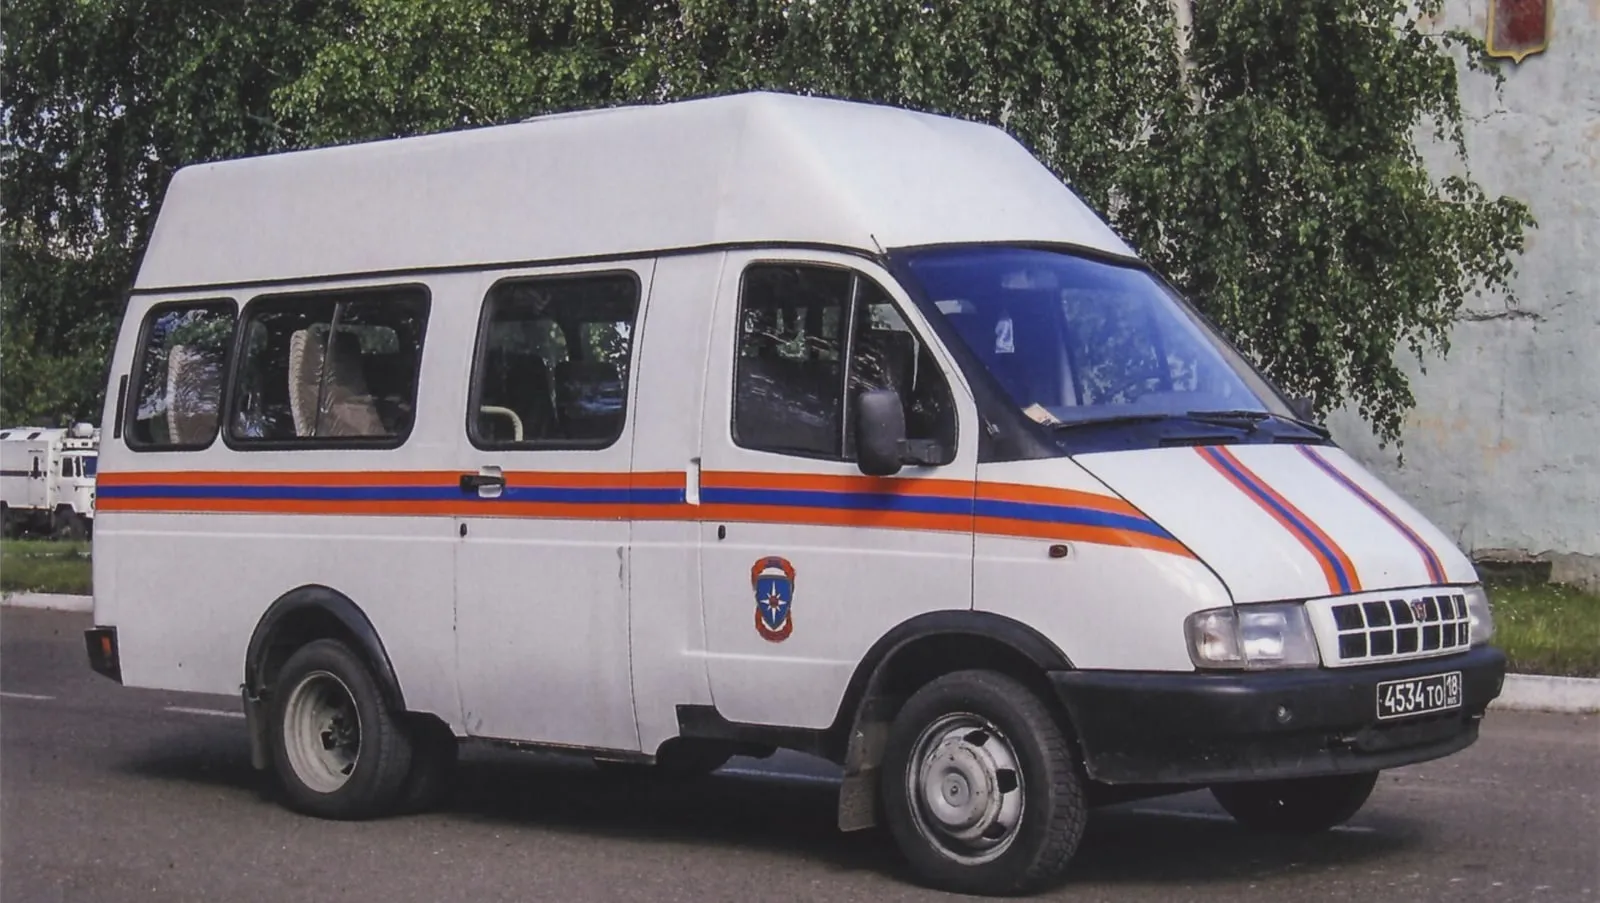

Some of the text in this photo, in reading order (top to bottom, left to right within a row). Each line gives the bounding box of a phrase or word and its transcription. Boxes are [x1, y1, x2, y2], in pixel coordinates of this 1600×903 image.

[1385, 682, 1424, 713] 4534
[1426, 685, 1443, 707] TO
[1446, 675, 1457, 696] 18
